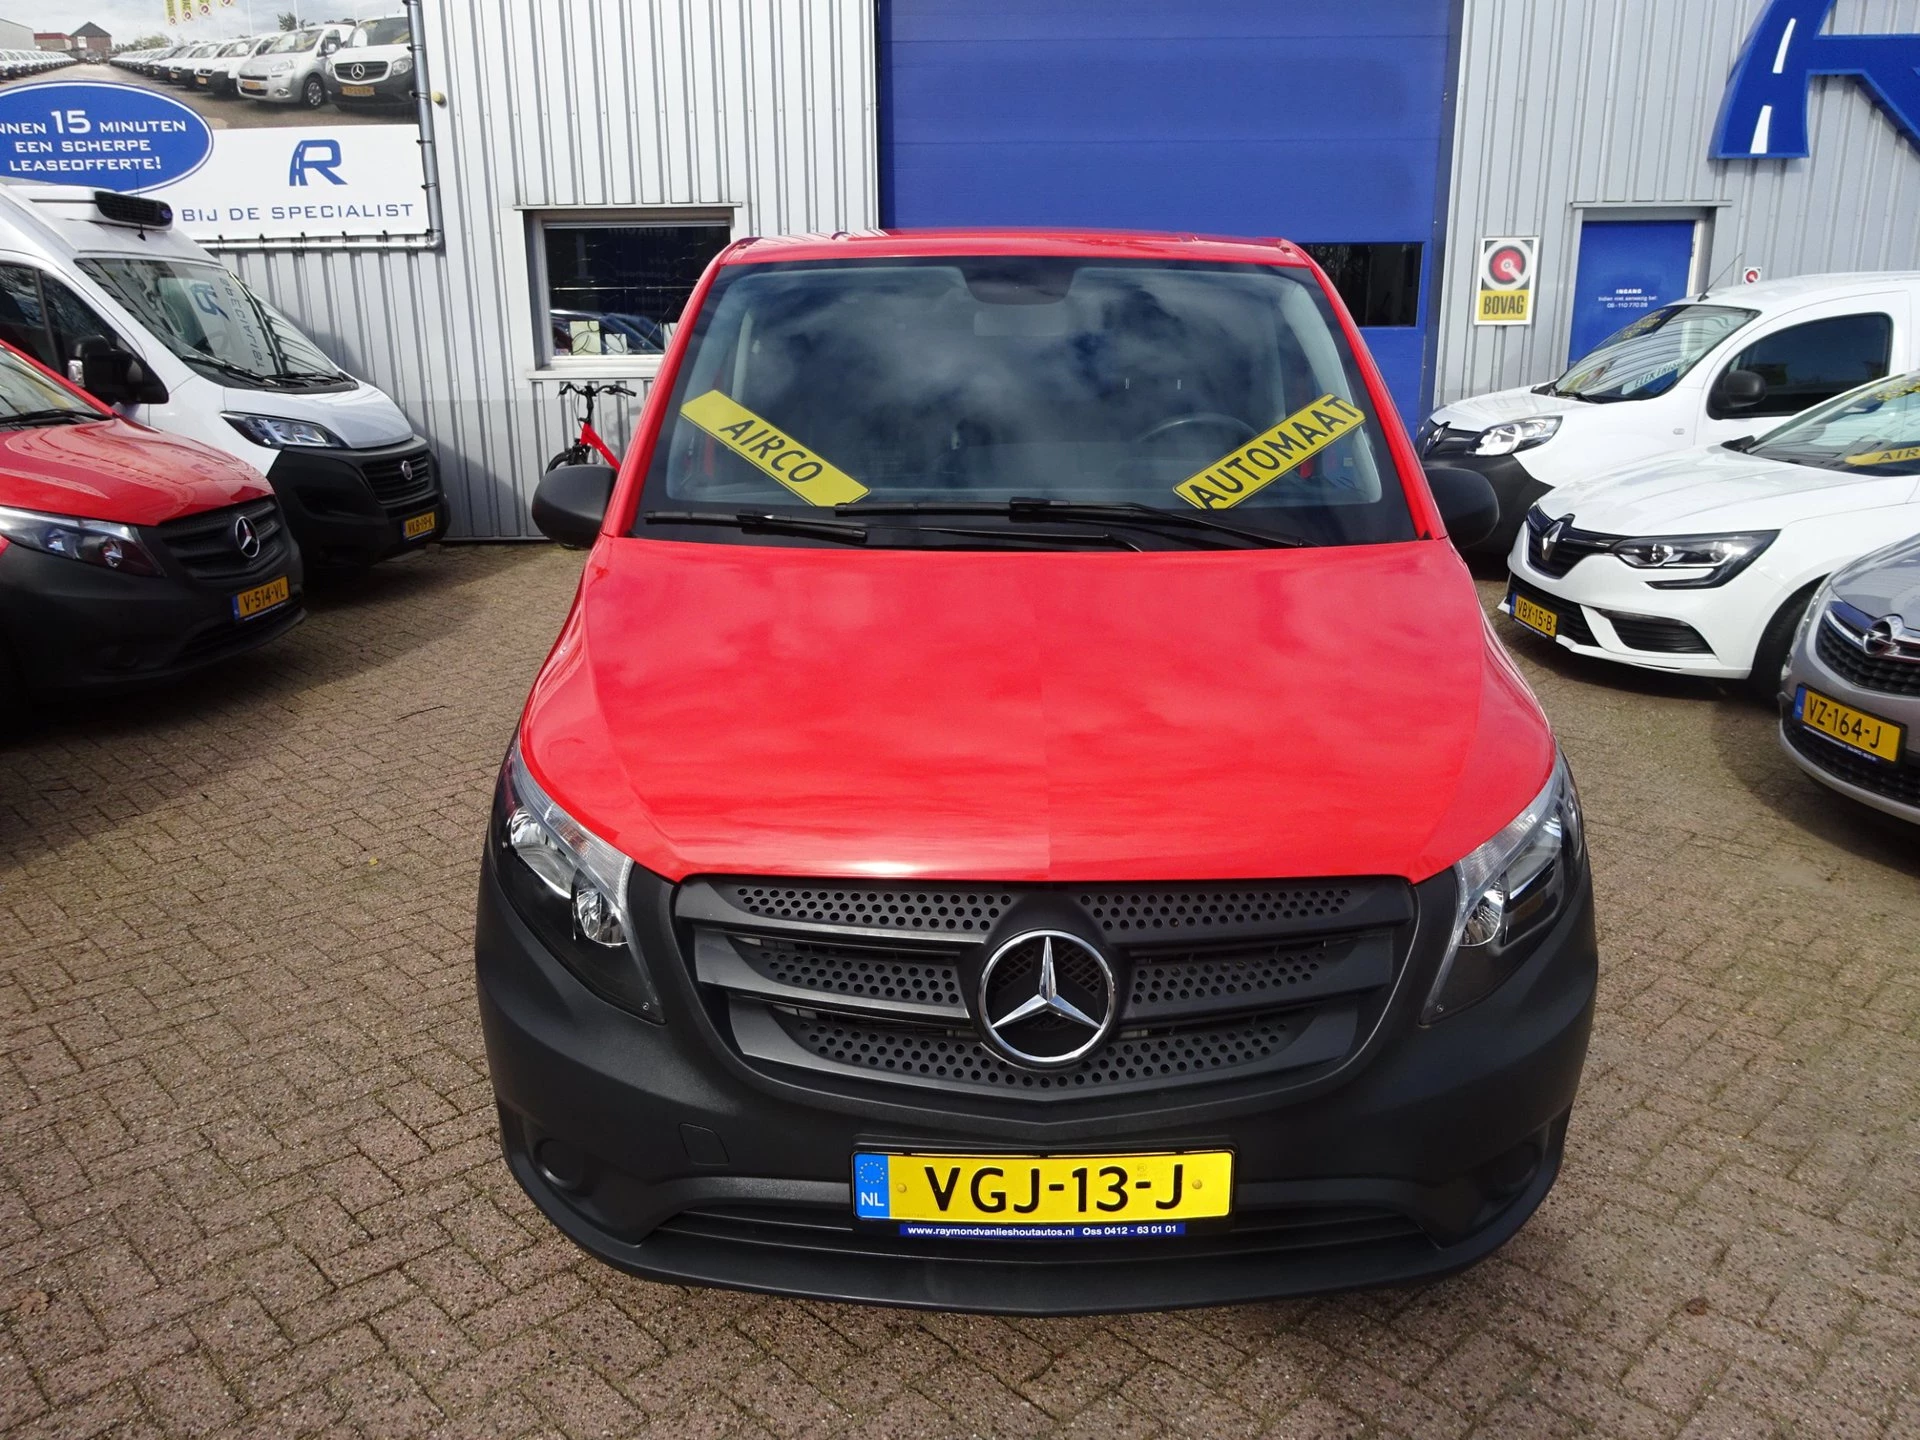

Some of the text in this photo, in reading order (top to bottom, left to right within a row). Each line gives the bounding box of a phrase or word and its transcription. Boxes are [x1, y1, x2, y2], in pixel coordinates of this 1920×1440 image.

[51, 109, 91, 135] 15
[99, 120, 187, 133] MINUTEN
[15, 139, 151, 153] EEN SCHERPE
[9, 156, 161, 172] LEASEOFFERTE!
[181, 203, 414, 222] BIJ DE SPECIALIST
[1483, 294, 1525, 315] BOVAG
[719, 419, 823, 483] AIRCO
[1188, 396, 1358, 510] AUTOMAAT
[243, 581, 286, 612] V-514-VL
[1517, 600, 1553, 631] VBX-15-B
[1808, 695, 1882, 750] VZ-164-J
[861, 1163, 1184, 1214] NL VGJ-13-J
[907, 1227, 1075, 1237] www.raymondvanlieshoutautos.nl
[1082, 1227, 1102, 1236] Oss
[1104, 1226, 1128, 1235] 0412
[1136, 1226, 1149, 1234] 63
[1151, 1225, 1162, 1234] 01
[1165, 1225, 1177, 1233] 01
